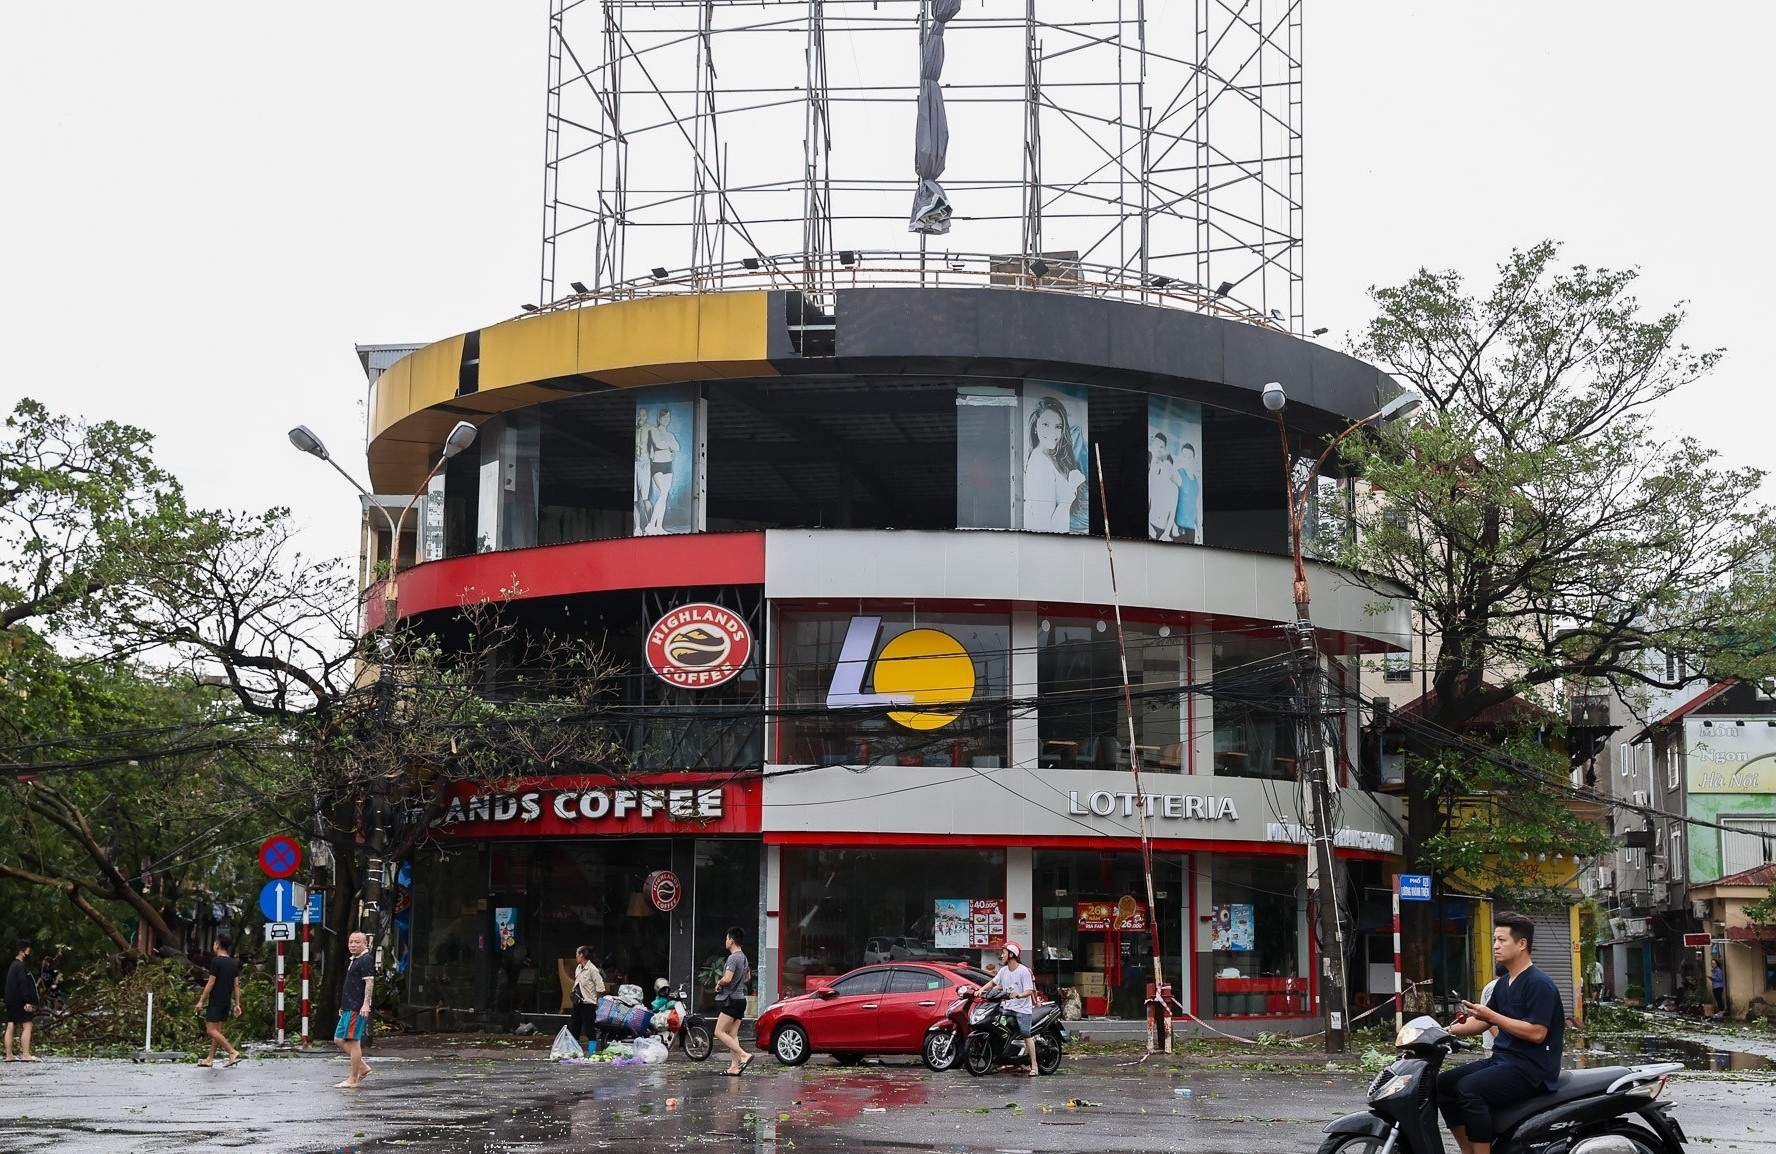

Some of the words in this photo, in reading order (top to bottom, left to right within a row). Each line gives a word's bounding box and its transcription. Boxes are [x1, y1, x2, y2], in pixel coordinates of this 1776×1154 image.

[651, 609, 744, 645] HIGHLANDS
[662, 661, 733, 684] COFFEE
[1700, 723, 1739, 737] Món
[1701, 748, 1749, 764] Ngon
[1699, 771, 1725, 788] Hà
[1729, 772, 1759, 791] Nội
[432, 793, 541, 821] ANDS
[553, 789, 723, 819] COFFEE
[1068, 790, 1239, 820] LOTTERIA
[653, 873, 679, 891] HIGHLANDS
[657, 899, 677, 909] COFFEE
[1088, 905, 1101, 915] 26
